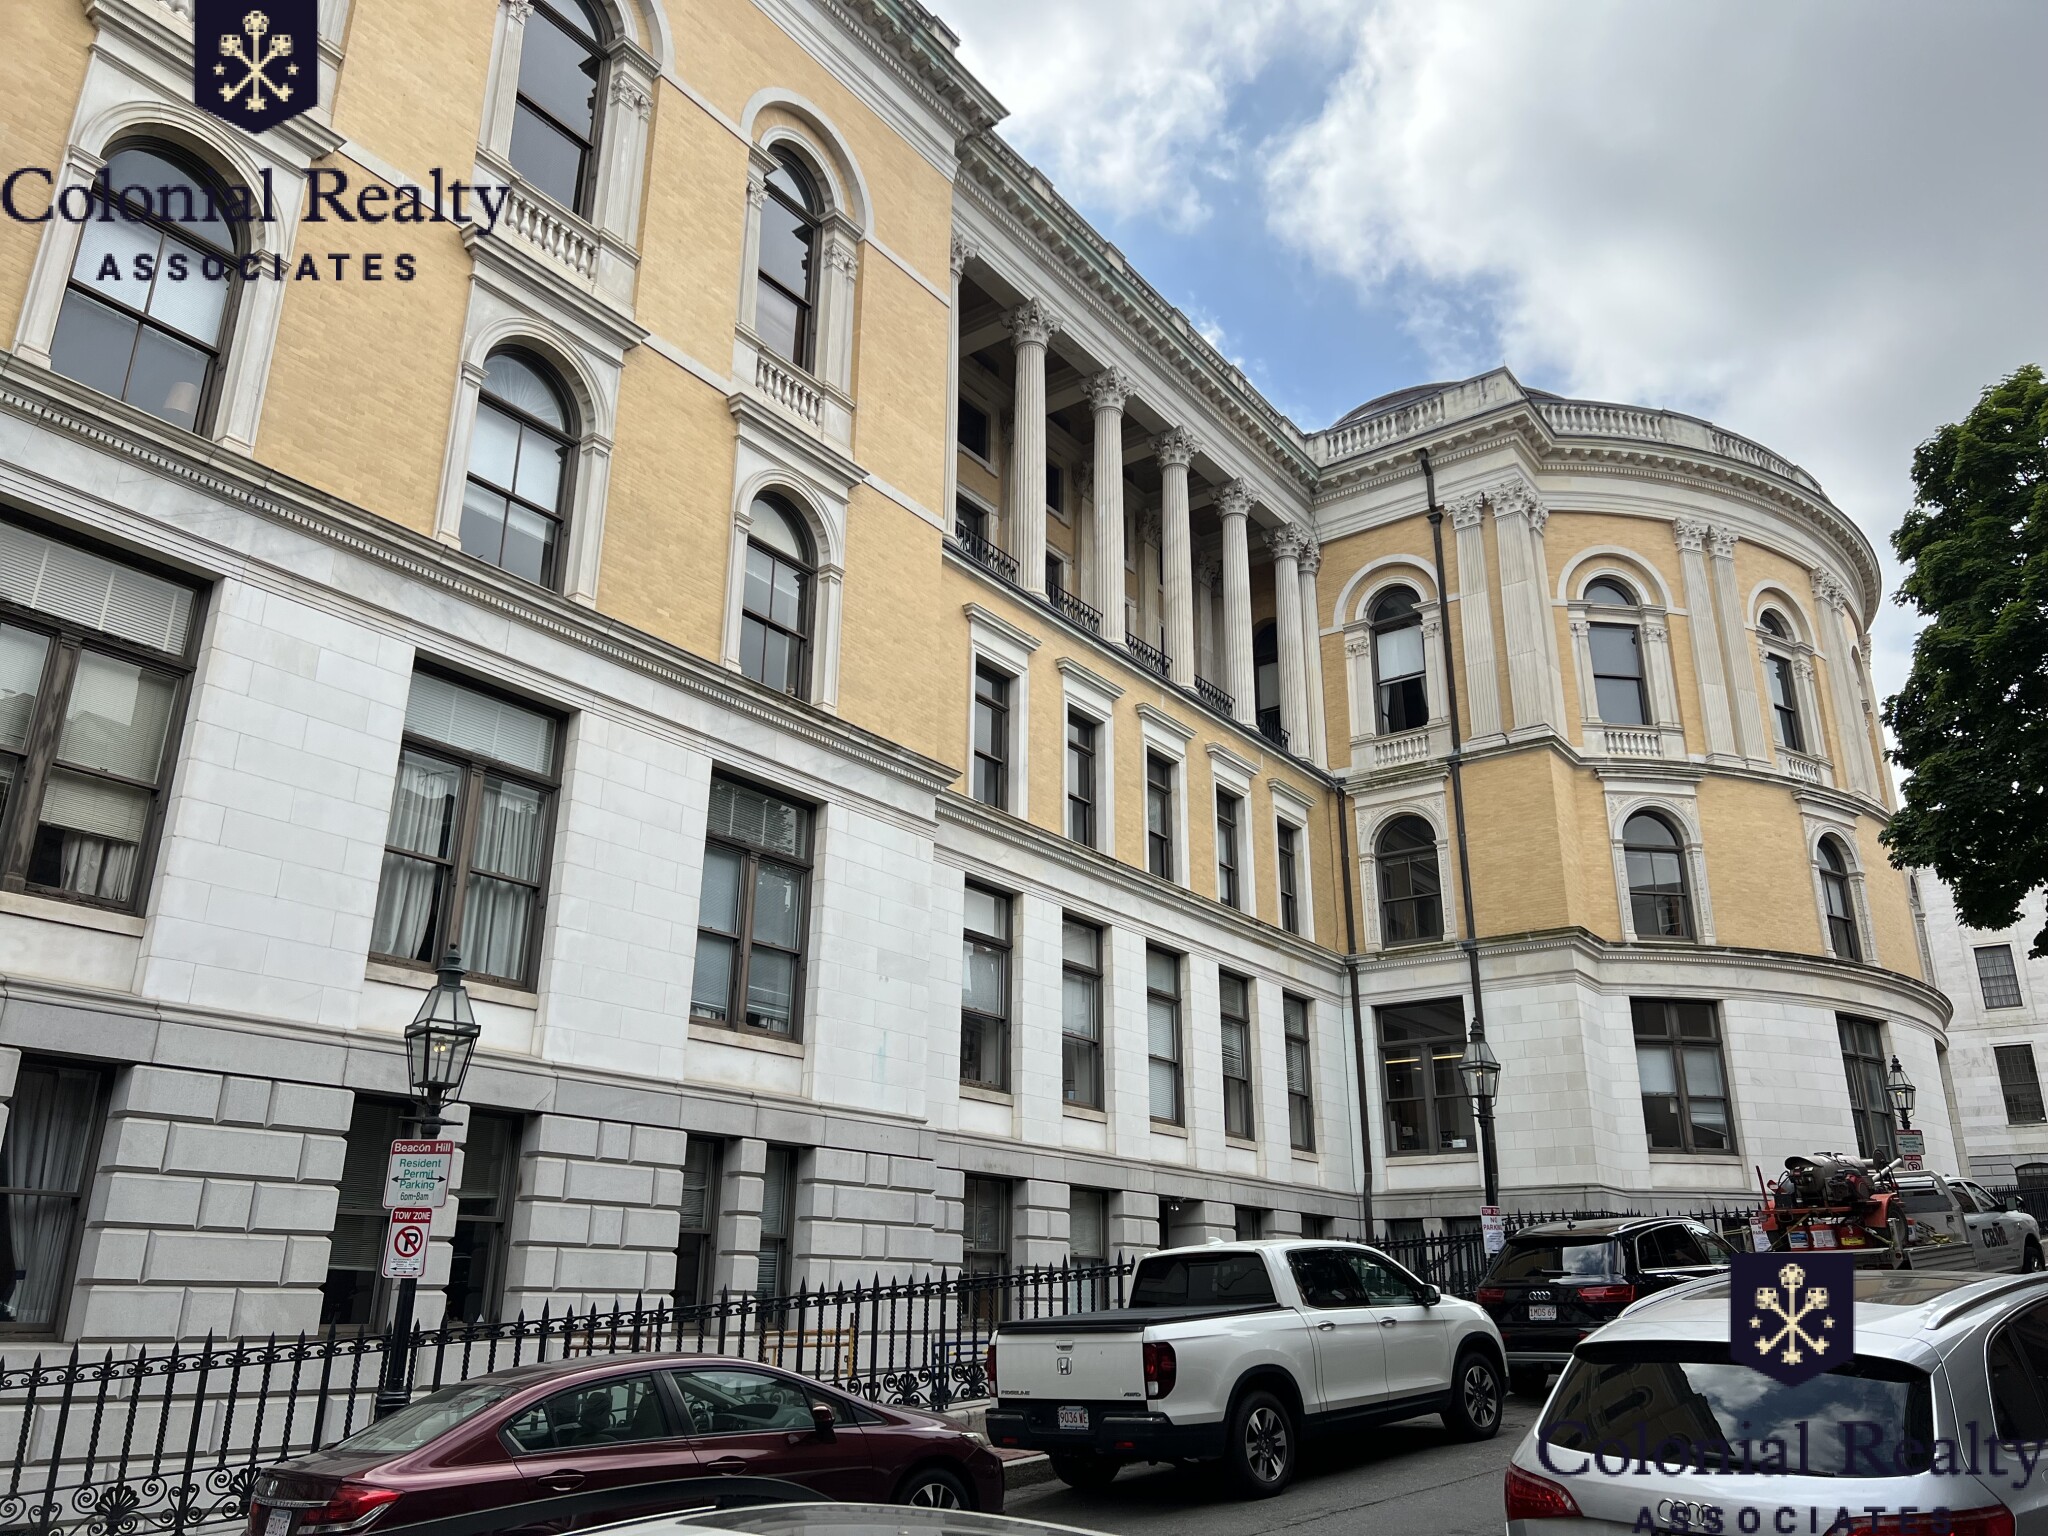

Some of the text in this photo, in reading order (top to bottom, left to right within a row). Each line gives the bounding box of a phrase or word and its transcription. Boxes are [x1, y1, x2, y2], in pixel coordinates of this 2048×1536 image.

[394, 1143, 451, 1152] Beacon Hill
[399, 1158, 442, 1168] Resident
[403, 1169, 434, 1178] Permit
[399, 1180, 435, 1191] Parking
[394, 1211, 431, 1220] TOW ZONE
[1060, 1411, 1078, 1423] 9036
